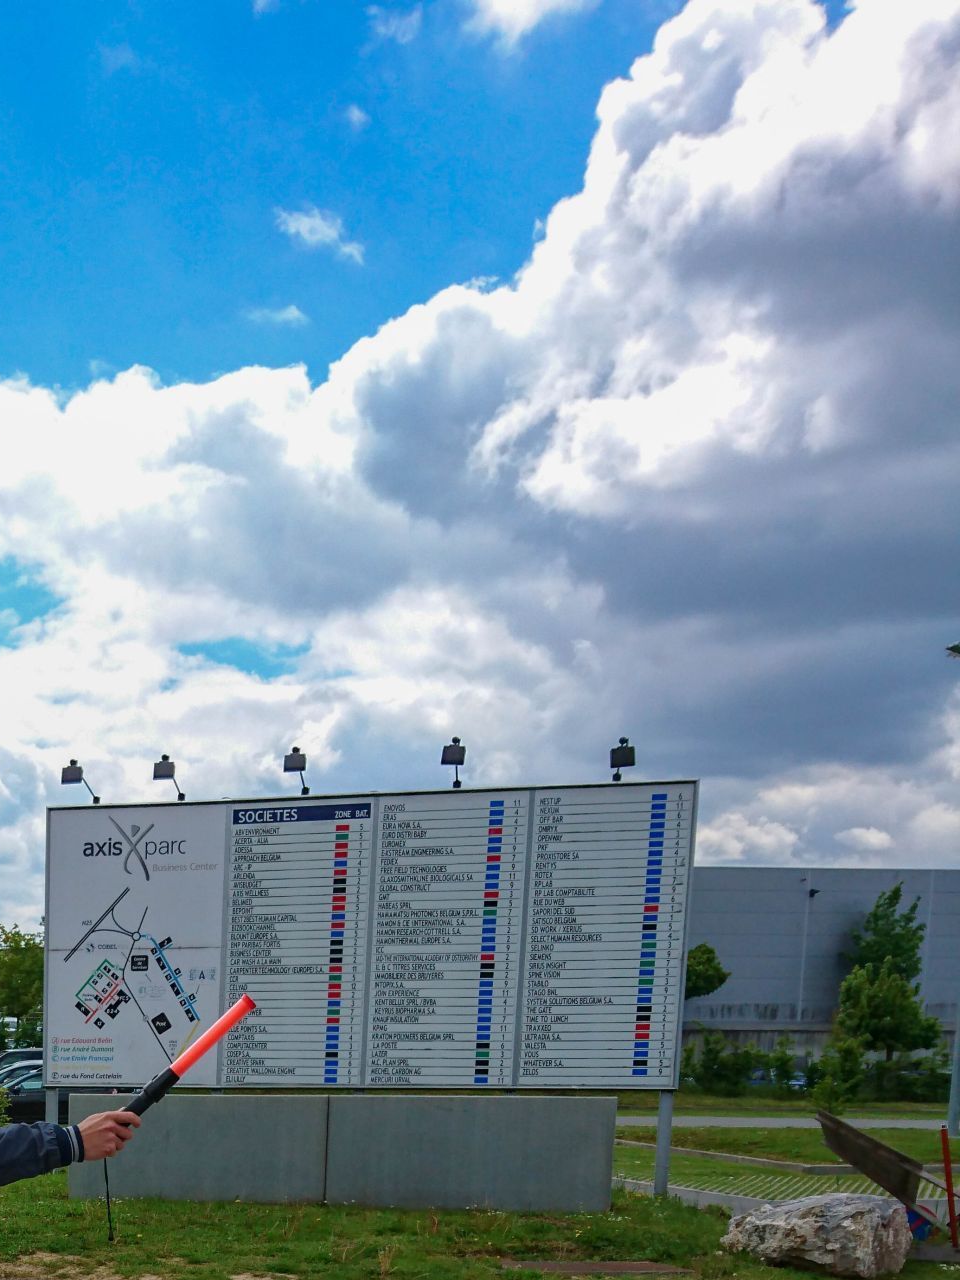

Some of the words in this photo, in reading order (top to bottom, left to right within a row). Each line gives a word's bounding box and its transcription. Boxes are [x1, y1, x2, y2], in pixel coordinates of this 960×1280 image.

[238, 809, 298, 823] SOCIETES
[356, 810, 368, 818] BAT.
[83, 838, 122, 857] axis
[145, 840, 187, 859] parc
[152, 864, 187, 872] Business
[410, 865, 447, 873] TECHNOLOGIES
